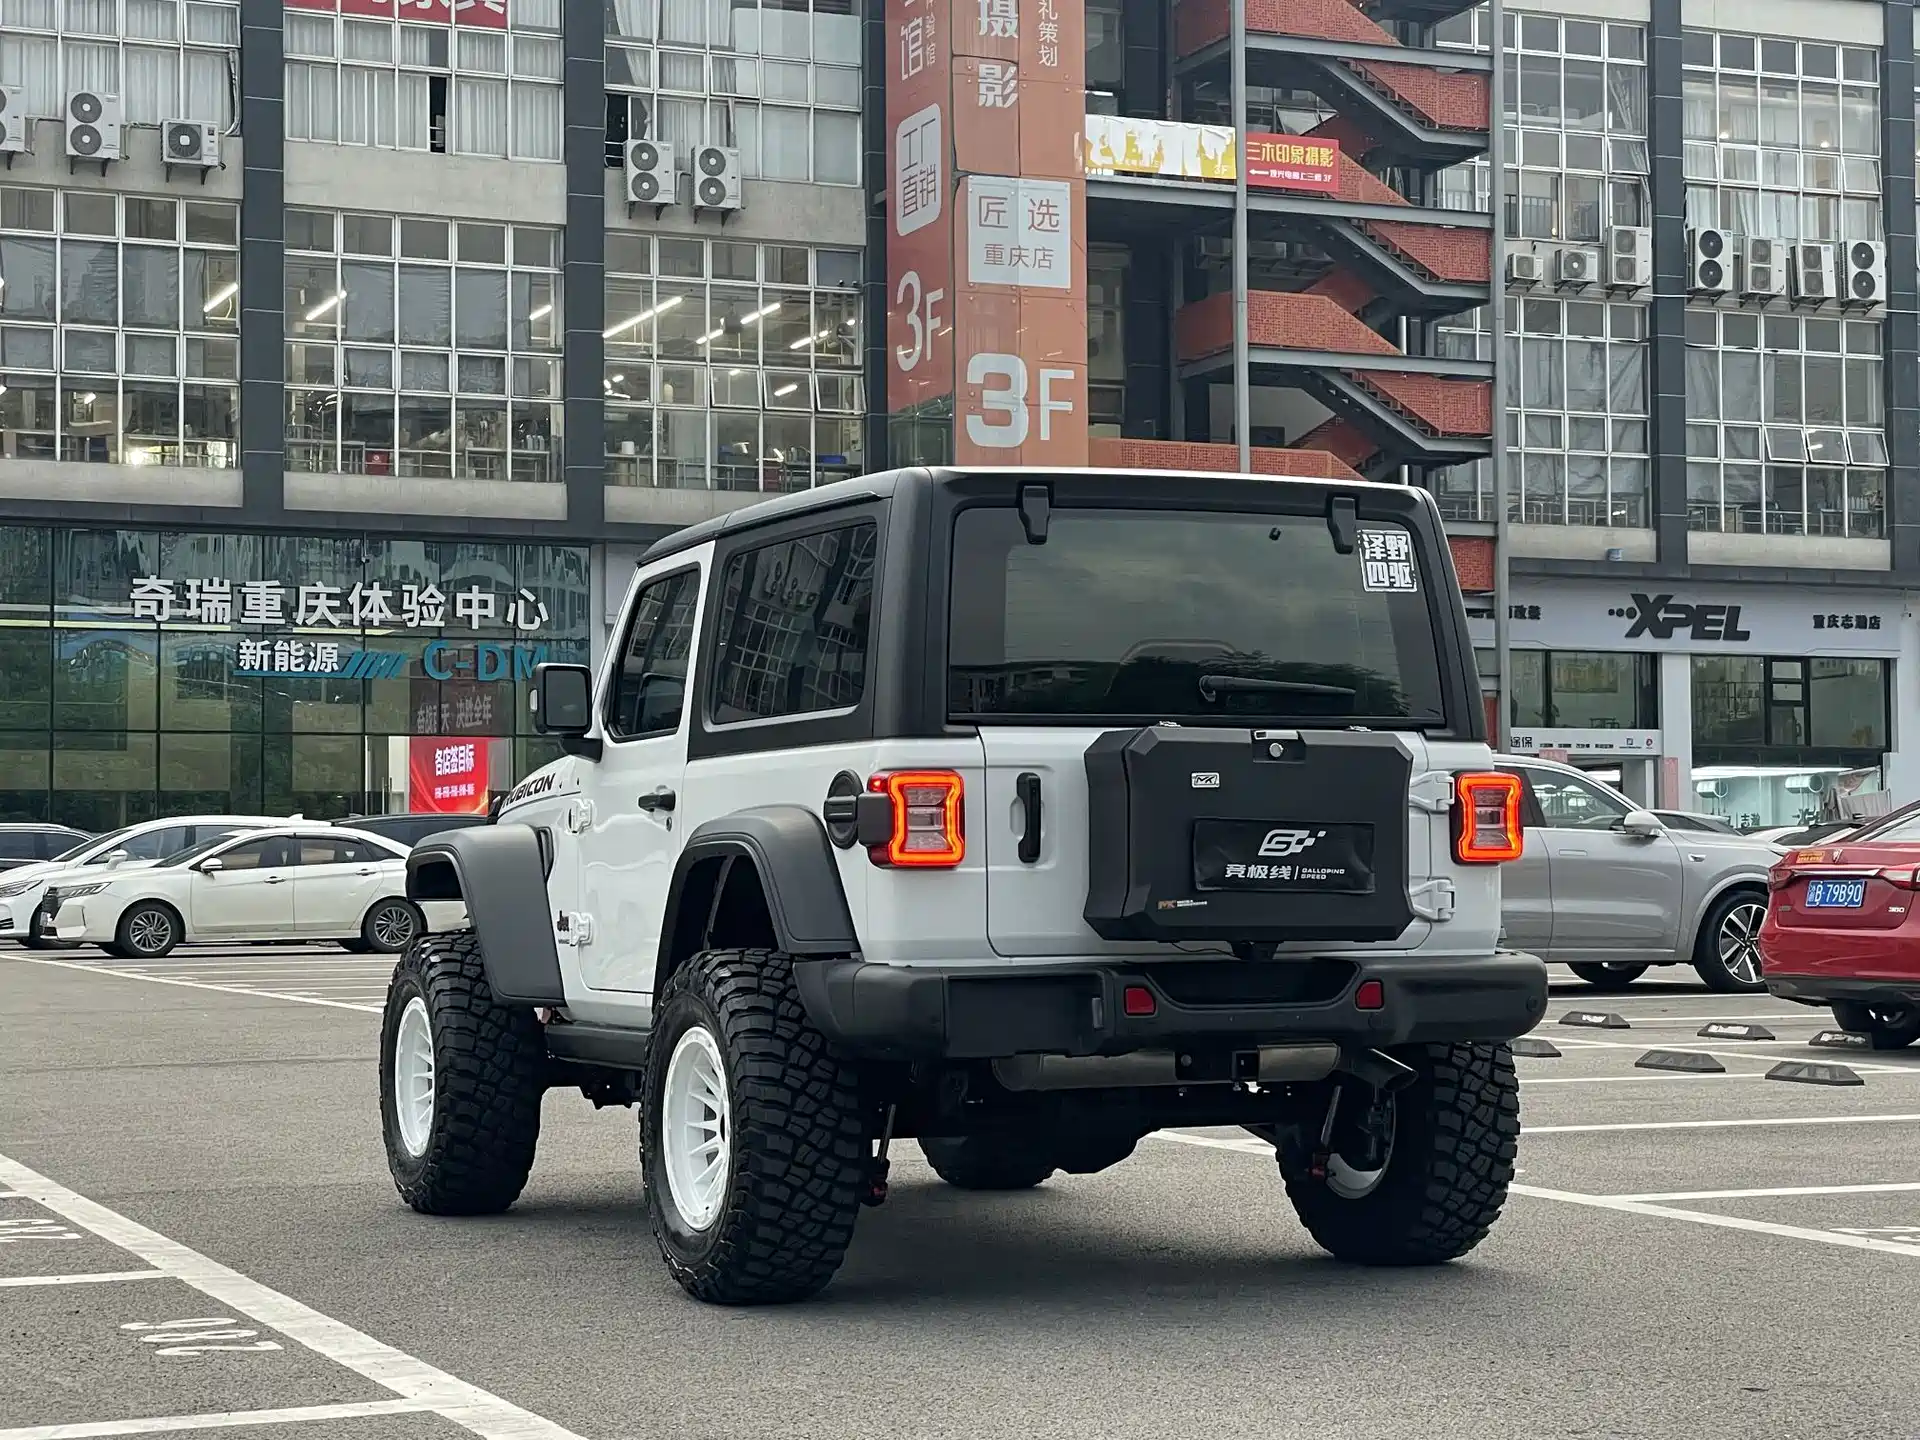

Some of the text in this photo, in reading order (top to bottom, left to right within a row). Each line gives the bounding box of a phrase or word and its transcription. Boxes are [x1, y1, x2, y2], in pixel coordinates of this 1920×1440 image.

[902, 117, 936, 172] 工厂
[977, 195, 1060, 234] 匠选
[983, 243, 1054, 271] 重庆店
[896, 270, 944, 372] 3F
[965, 352, 1075, 448] 3F
[1361, 534, 1409, 560] 泽野
[1365, 561, 1413, 588] 四驱
[129, 574, 550, 631] 奇瑞重庆体验中心
[1624, 593, 1751, 642] XPEL
[238, 639, 340, 673] 新能源
